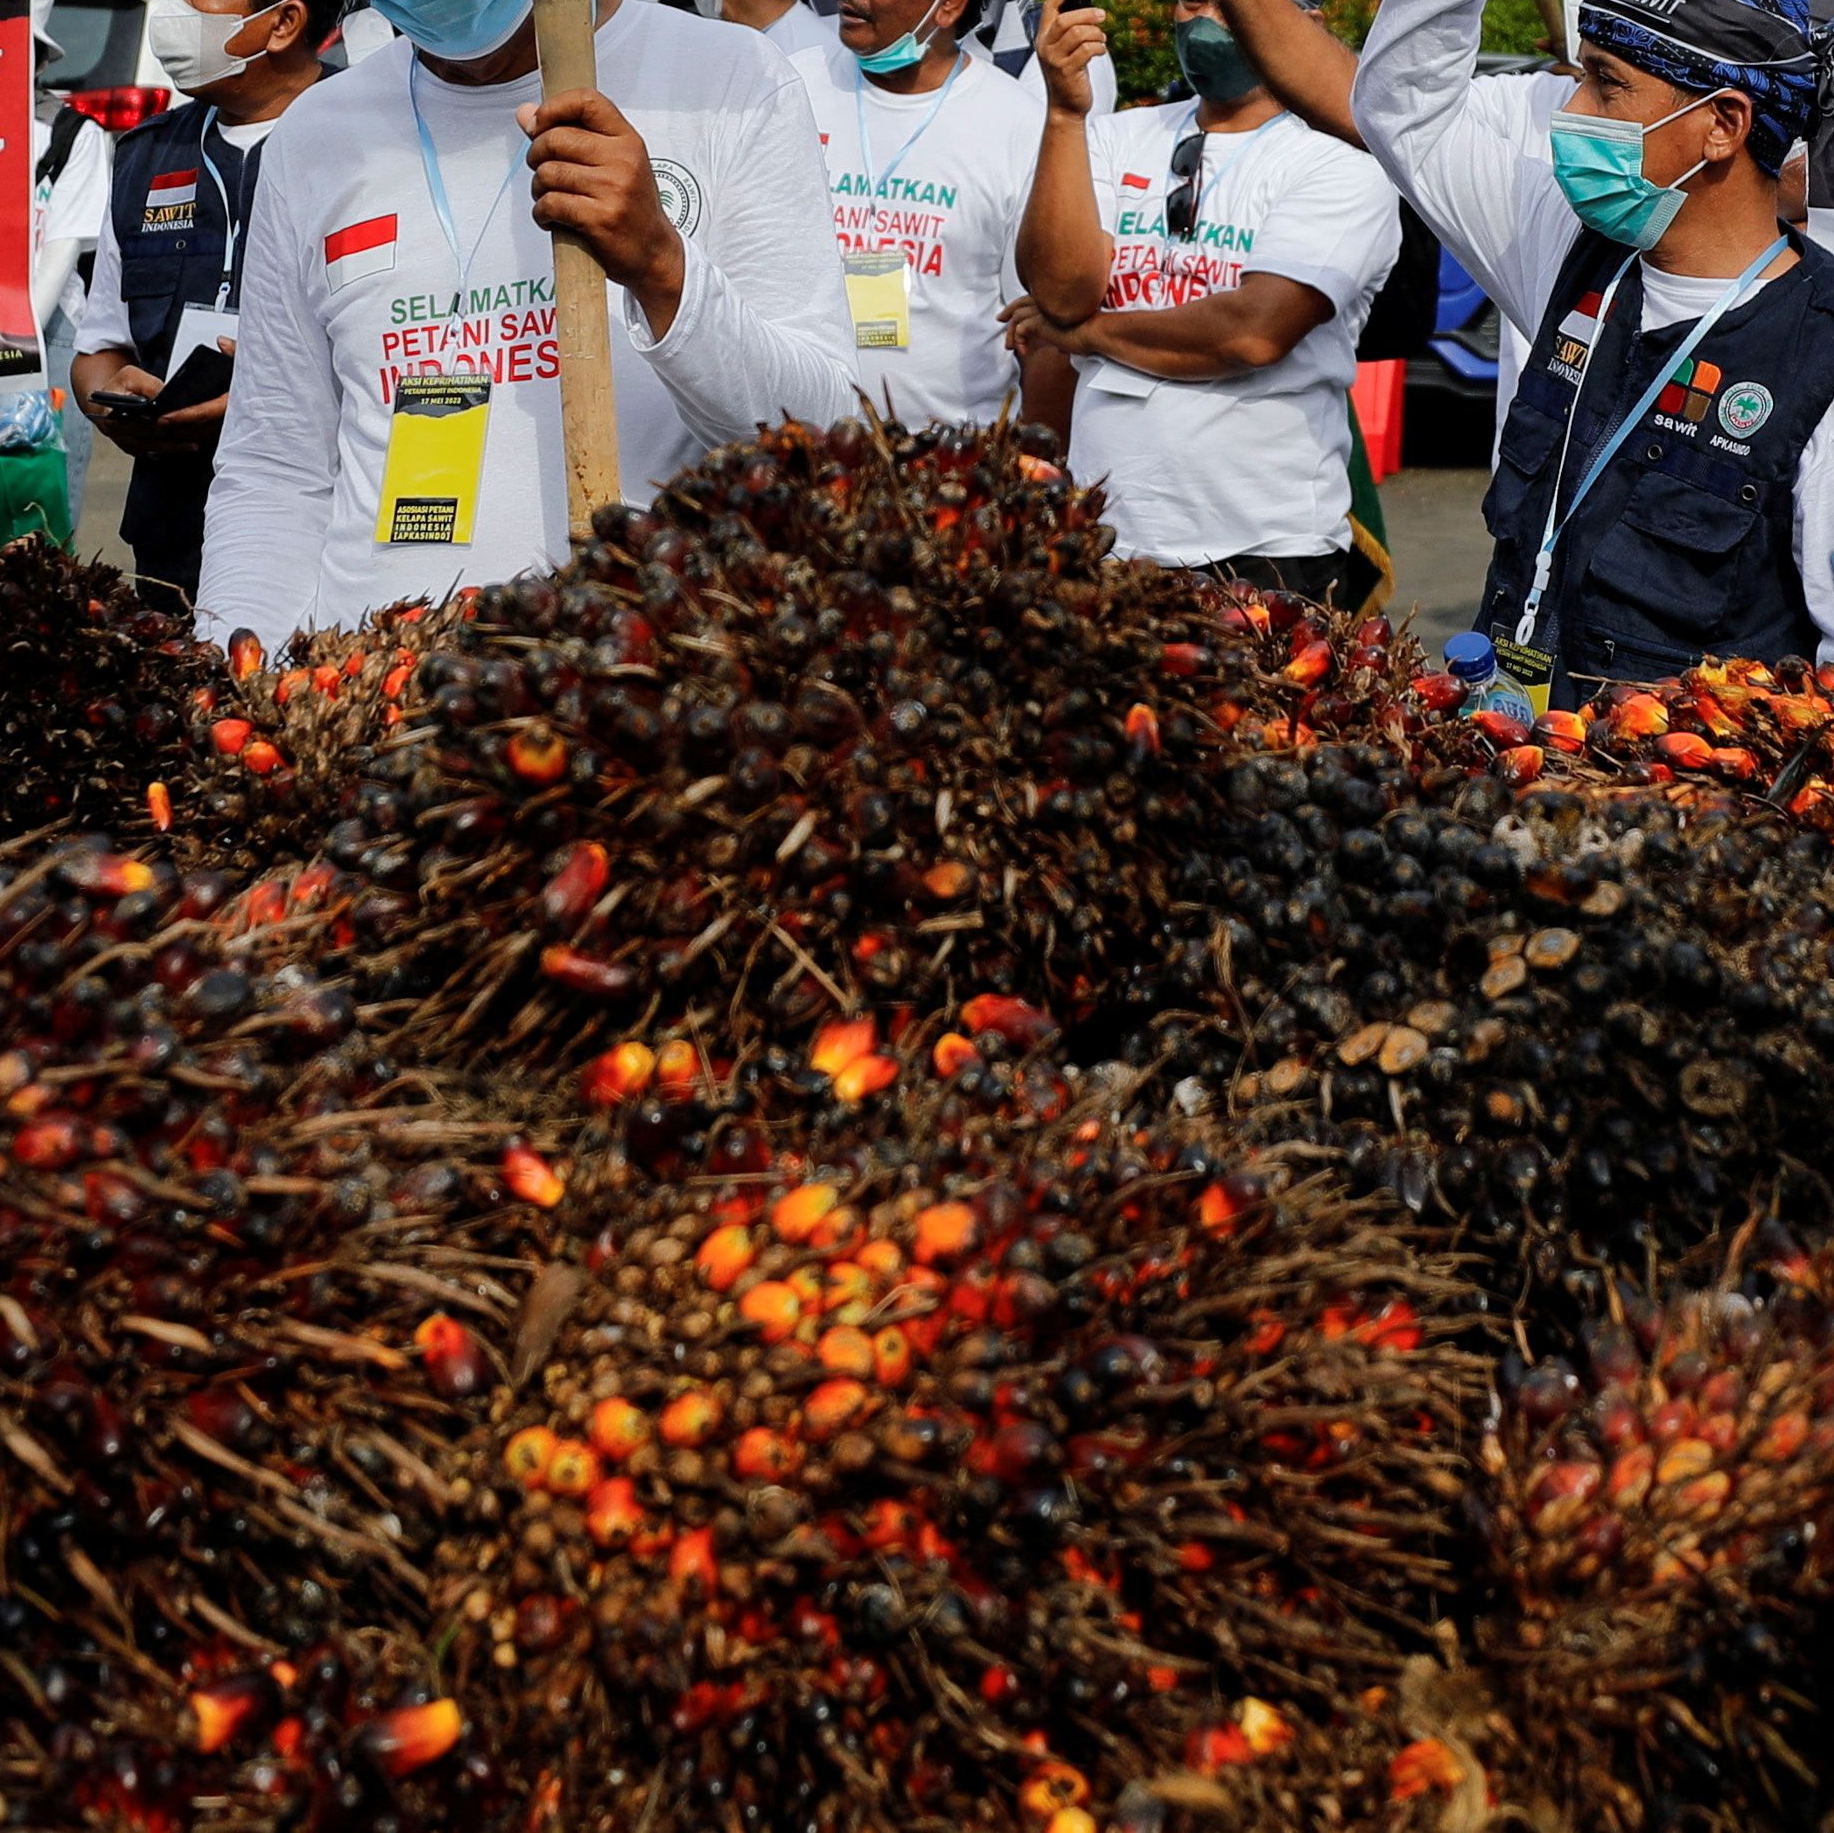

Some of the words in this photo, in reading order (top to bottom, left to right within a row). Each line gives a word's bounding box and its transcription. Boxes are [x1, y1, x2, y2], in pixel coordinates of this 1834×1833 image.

[143, 202, 197, 223] SAWIT
[141, 218, 194, 233] INDONESIA
[873, 209, 946, 239] SAWIT
[400, 376, 423, 387] AKSI
[423, 375, 489, 387] KEPRIHATINAN
[1652, 413, 1699, 439] sawit
[397, 505, 429, 514] ASOSIASI
[429, 505, 455, 514] PETANI
[396, 514, 426, 523] KELAPA
[427, 514, 454, 523] SAWIT
[395, 523, 452, 531] INDONESIA
